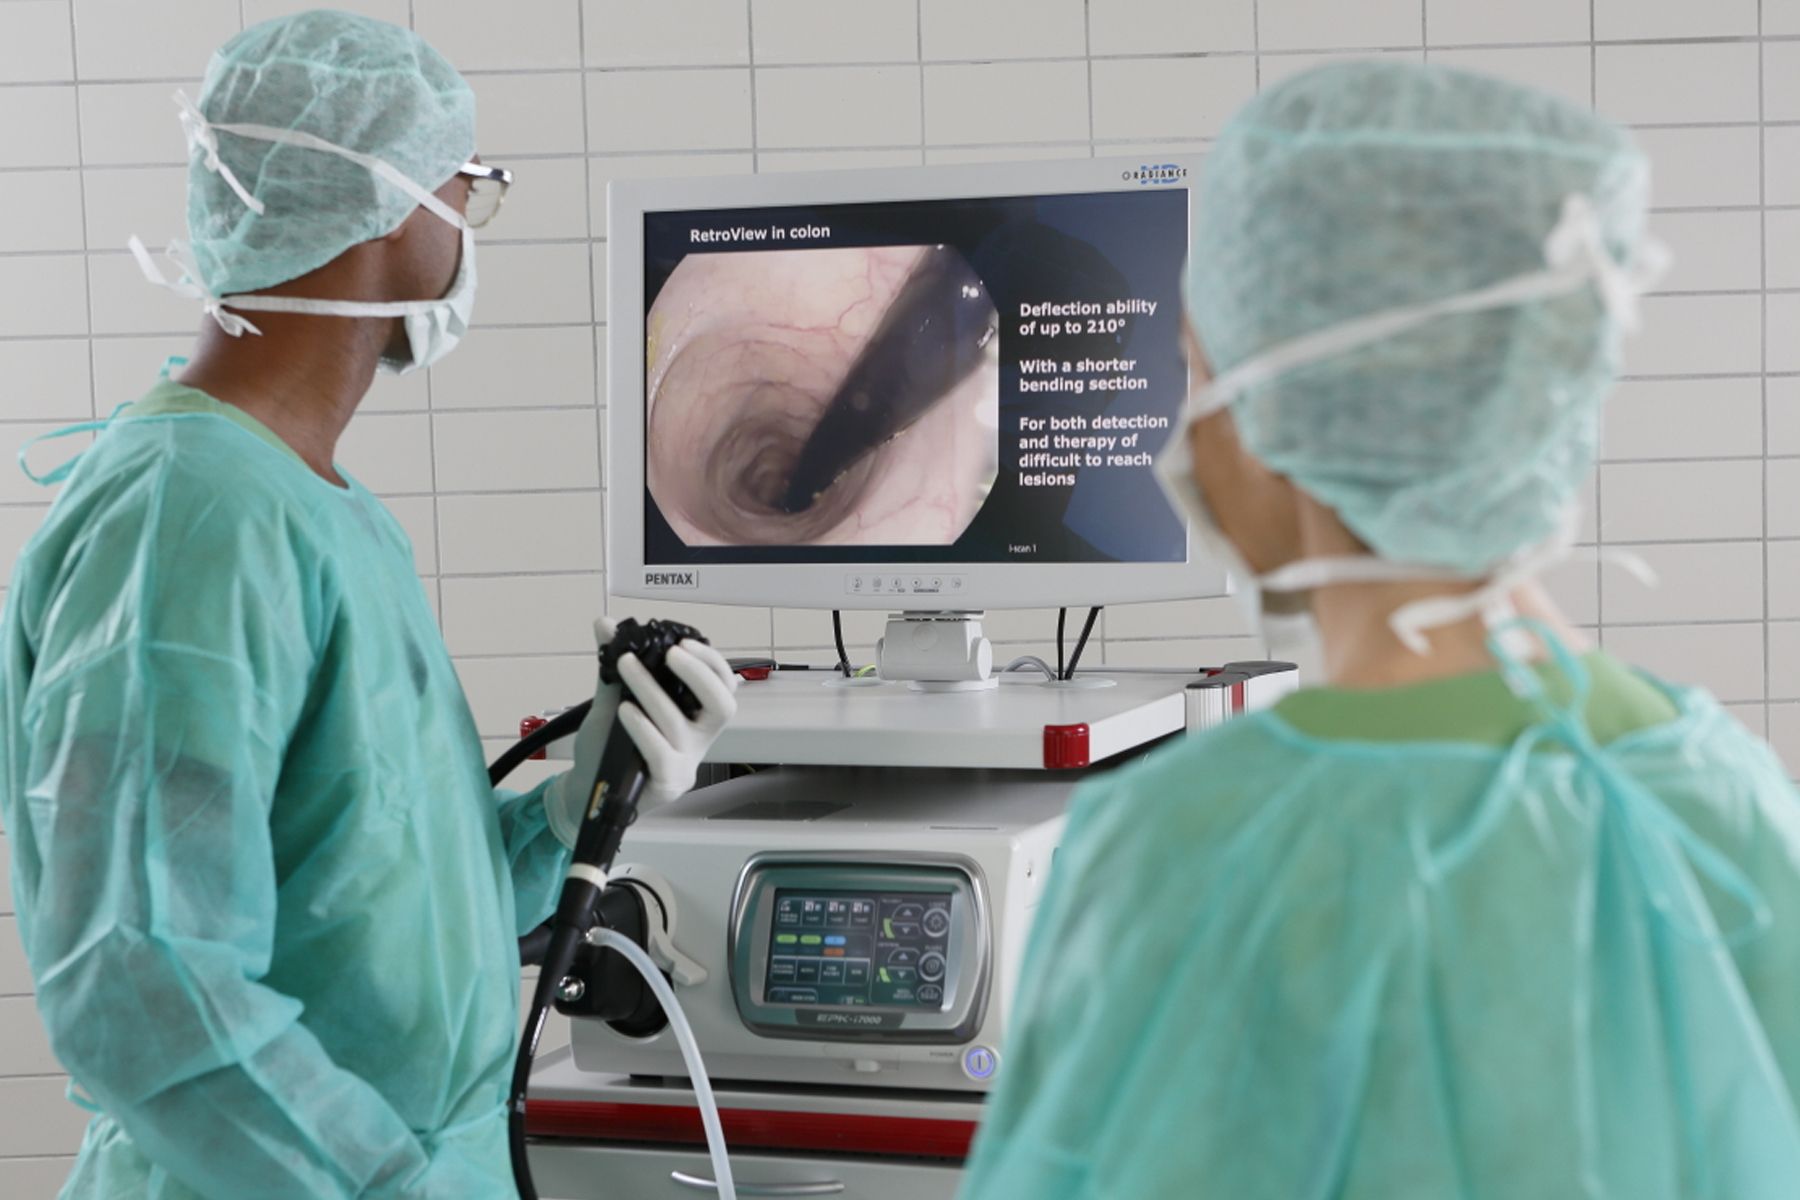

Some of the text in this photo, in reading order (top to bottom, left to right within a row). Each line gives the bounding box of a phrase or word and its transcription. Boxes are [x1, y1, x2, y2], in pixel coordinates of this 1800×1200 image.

[690, 224, 830, 242] RetroView in colon
[1020, 299, 1157, 317] Deflection ability
[1019, 321, 1036, 335] of
[1040, 323, 1061, 338] up
[1065, 321, 1082, 334] to
[1019, 358, 1137, 374] With a shorter
[1019, 376, 1148, 394] bending section
[1019, 414, 1168, 431] For both detection
[1019, 433, 1139, 451] and therapy of
[1018, 452, 1152, 468] difficult to reach
[1019, 472, 1076, 486] lesions
[645, 572, 693, 585] PENTAX
